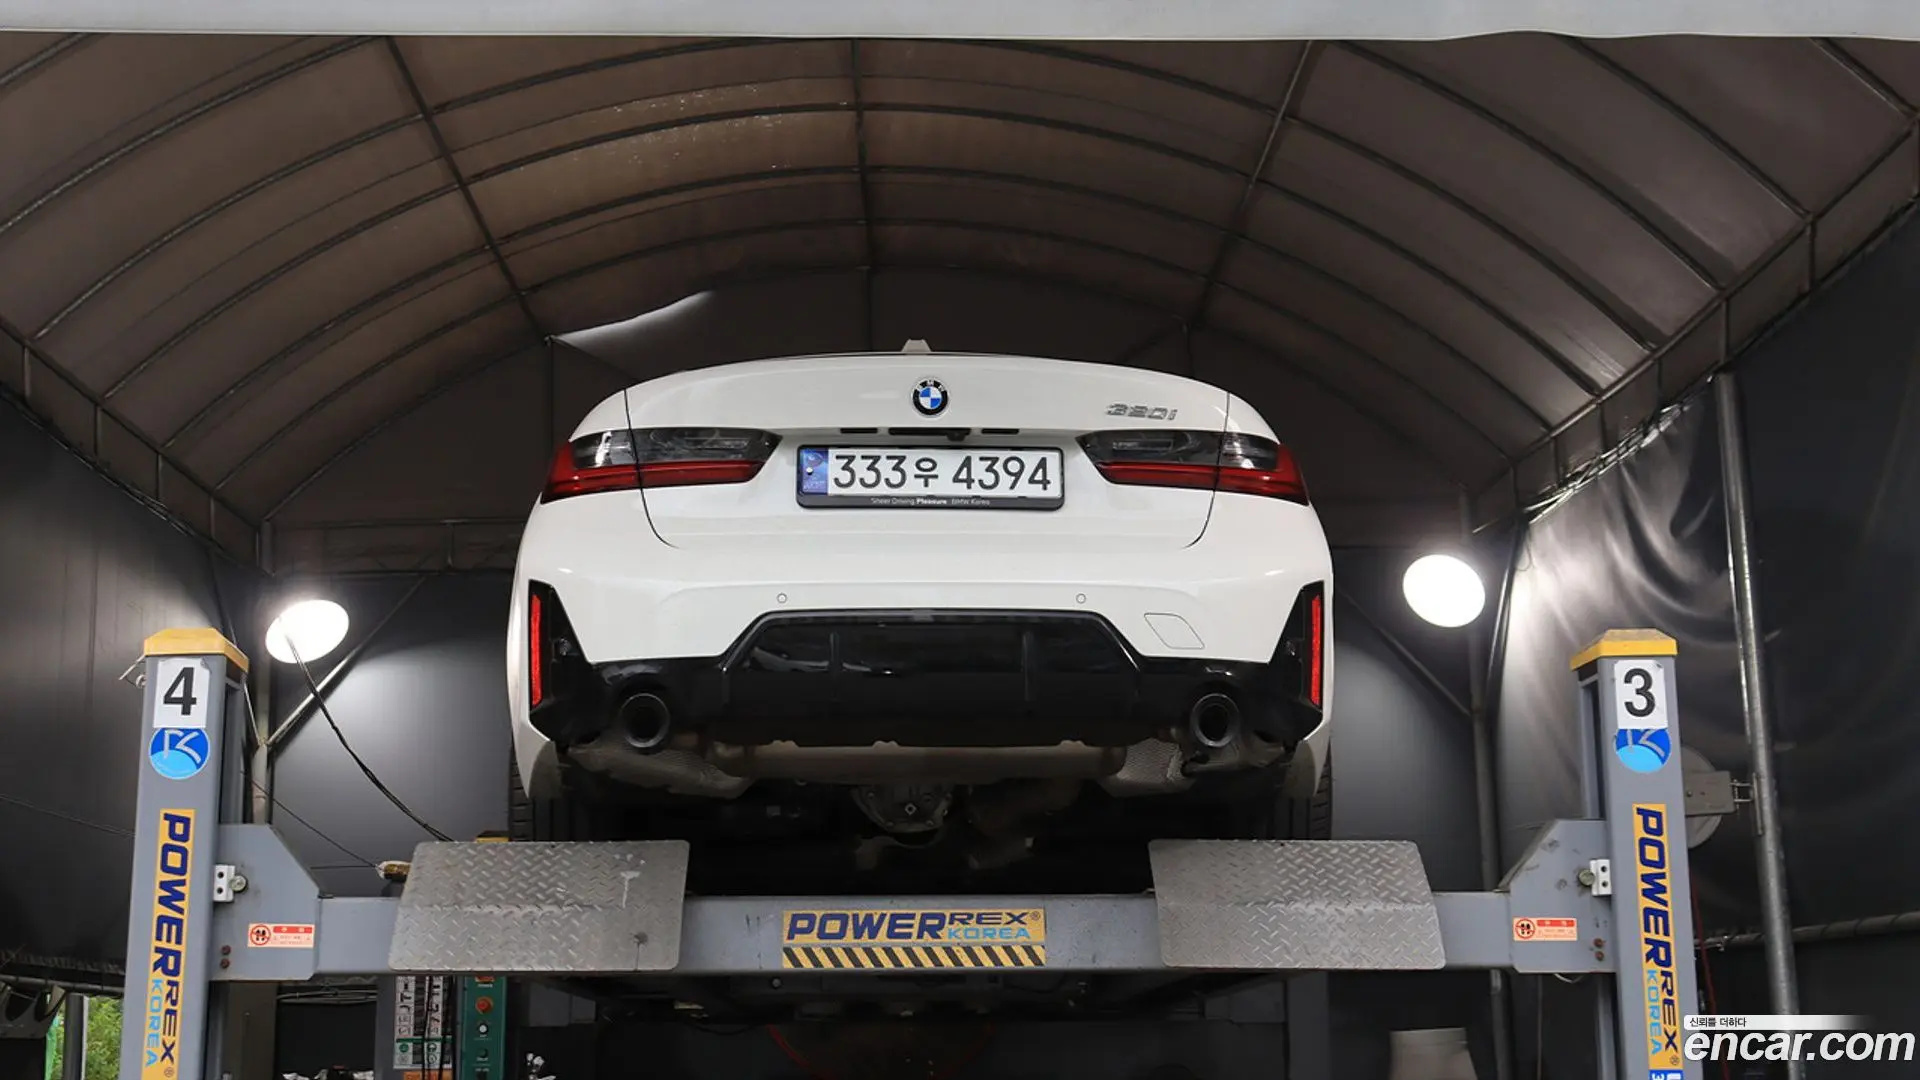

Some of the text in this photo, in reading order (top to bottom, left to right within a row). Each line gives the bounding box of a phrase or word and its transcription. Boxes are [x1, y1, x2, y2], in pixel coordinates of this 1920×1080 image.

[833, 455, 1051, 491] 333우 4394
[916, 497, 947, 505] Pleasure
[163, 666, 197, 715] 4
[1623, 668, 1656, 717] 3
[946, 927, 1030, 940] KOREA
[145, 979, 163, 1068] KOREA
[1644, 969, 1662, 1055] KOREA
